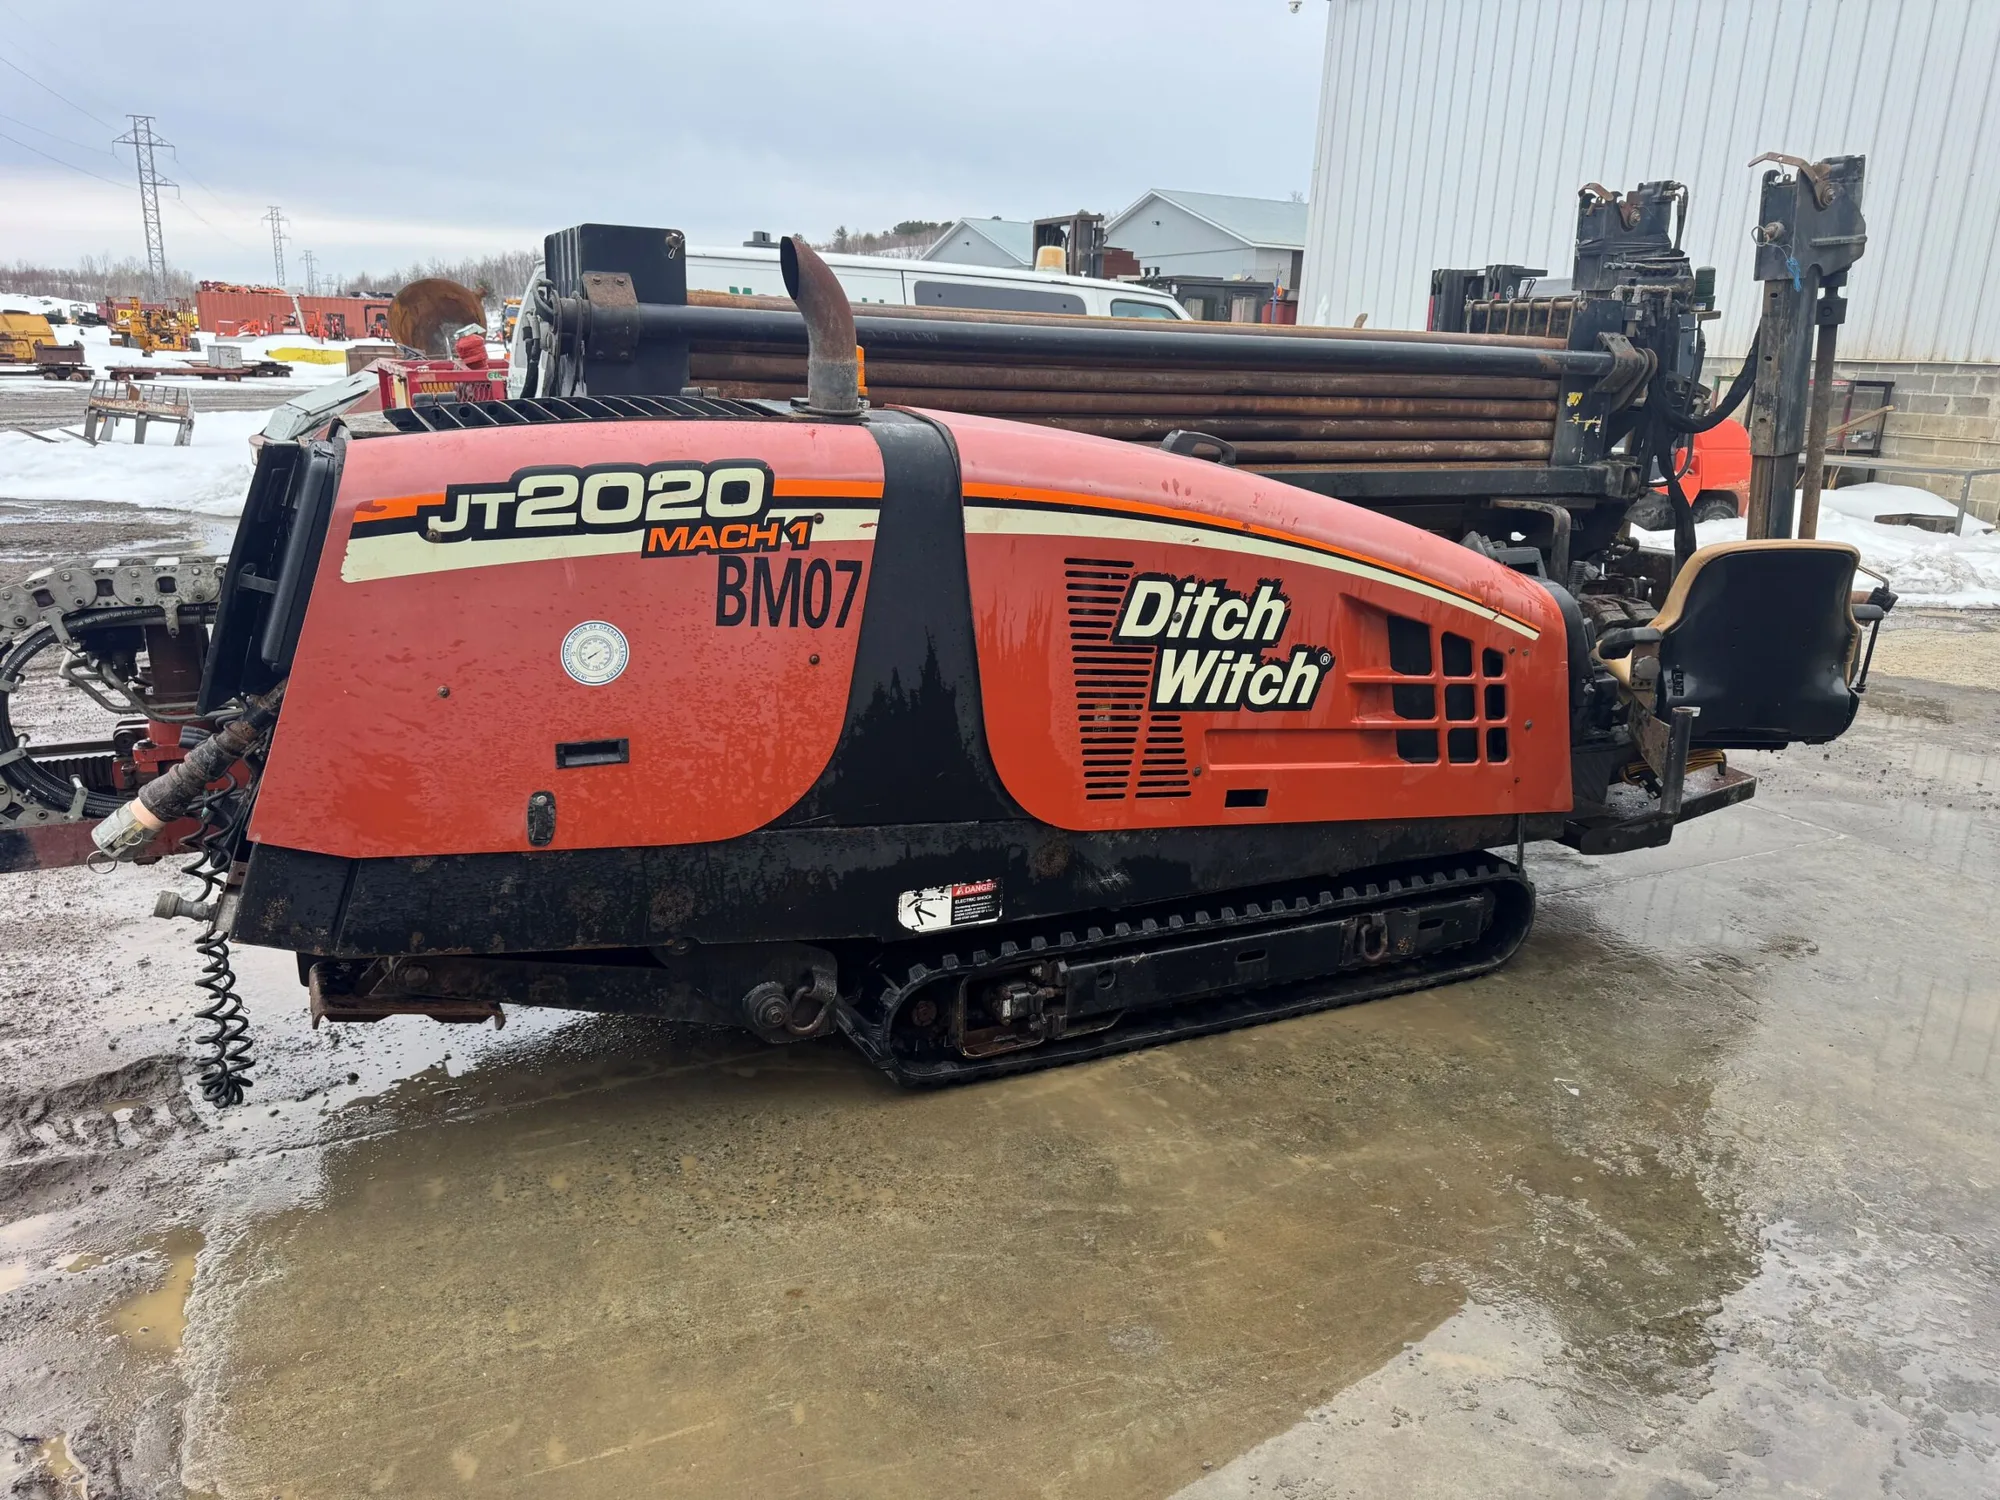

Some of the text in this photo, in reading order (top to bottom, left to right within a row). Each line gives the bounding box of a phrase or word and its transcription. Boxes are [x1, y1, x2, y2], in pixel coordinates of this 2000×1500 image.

[427, 467, 765, 532] JT2020
[648, 521, 809, 552] MACH 1
[715, 555, 863, 629] BM07
[1118, 580, 1286, 641] Ditch
[571, 626, 587, 639] UNION
[598, 624, 625, 648] OPERATING
[564, 641, 588, 680] INTERNATIONAL
[605, 650, 626, 678] ENGINEERS
